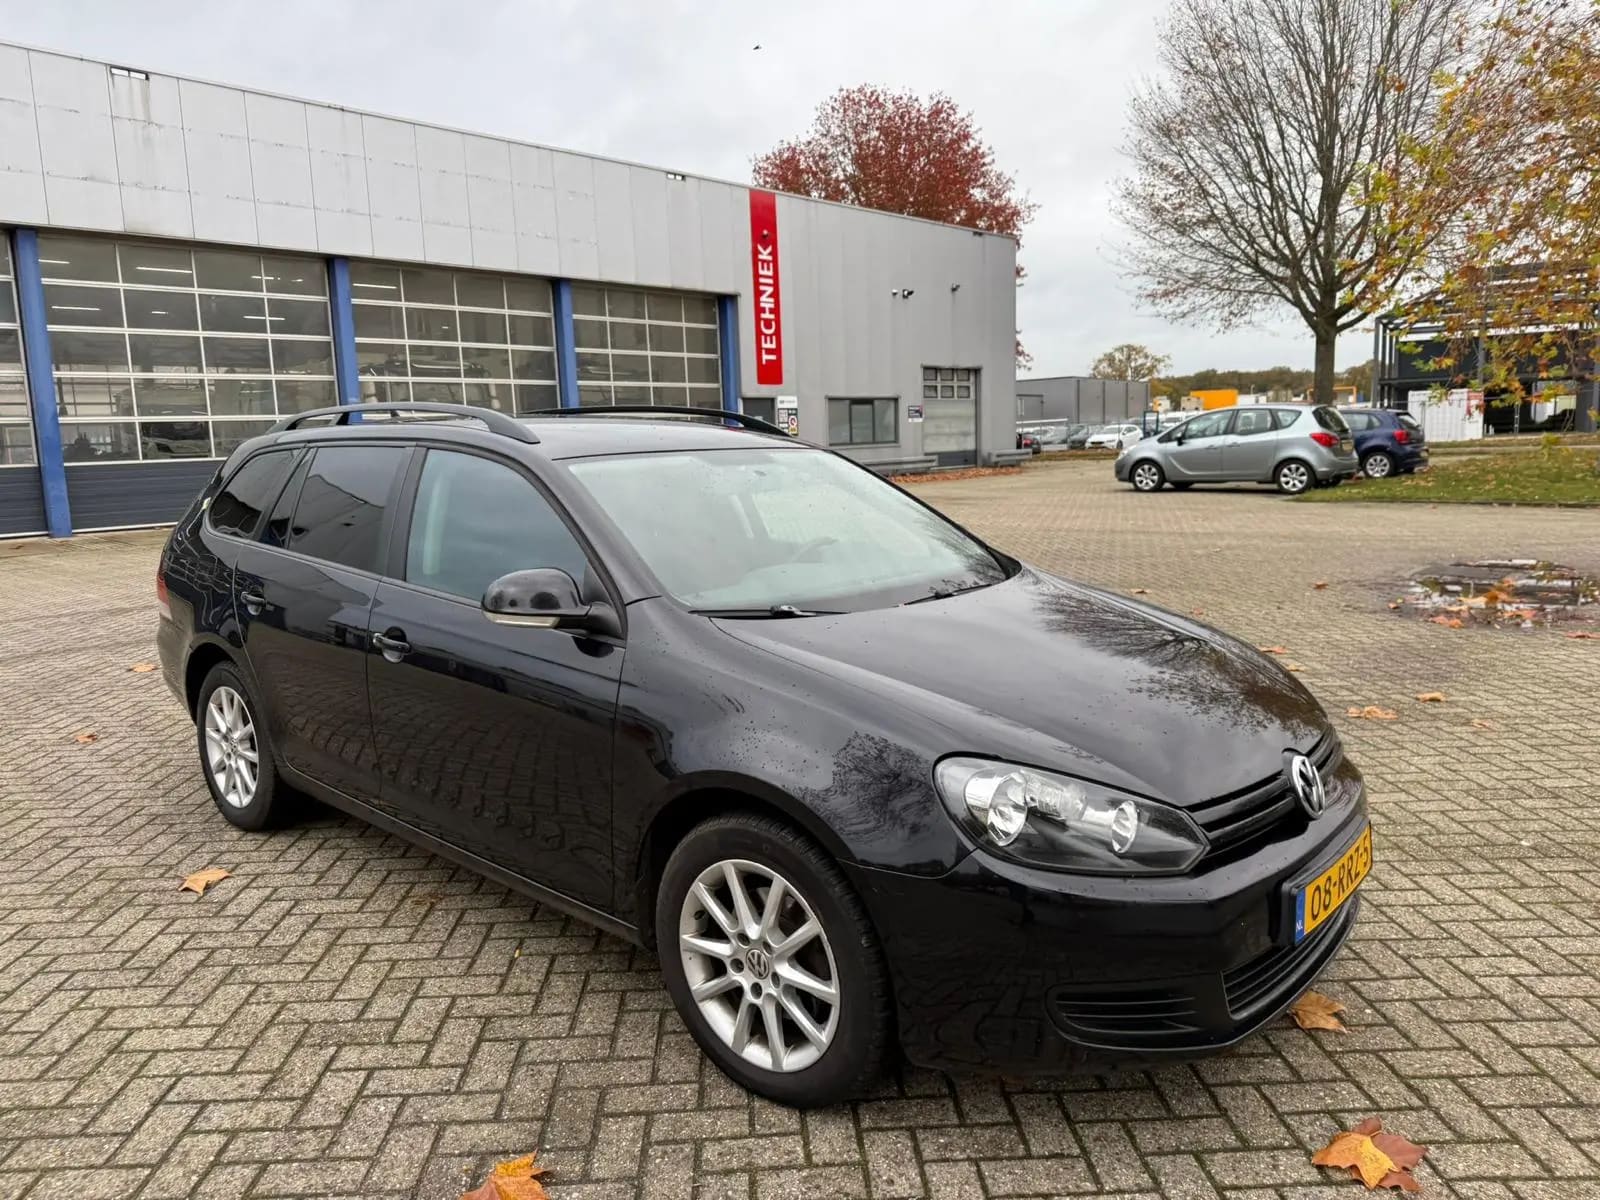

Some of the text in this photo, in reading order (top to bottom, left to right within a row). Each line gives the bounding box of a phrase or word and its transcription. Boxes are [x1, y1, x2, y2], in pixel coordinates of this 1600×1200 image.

[757, 243, 777, 365] TECHNIEK
[1311, 834, 1369, 921] 08-RRZ-5
[1295, 920, 1304, 933] NL
